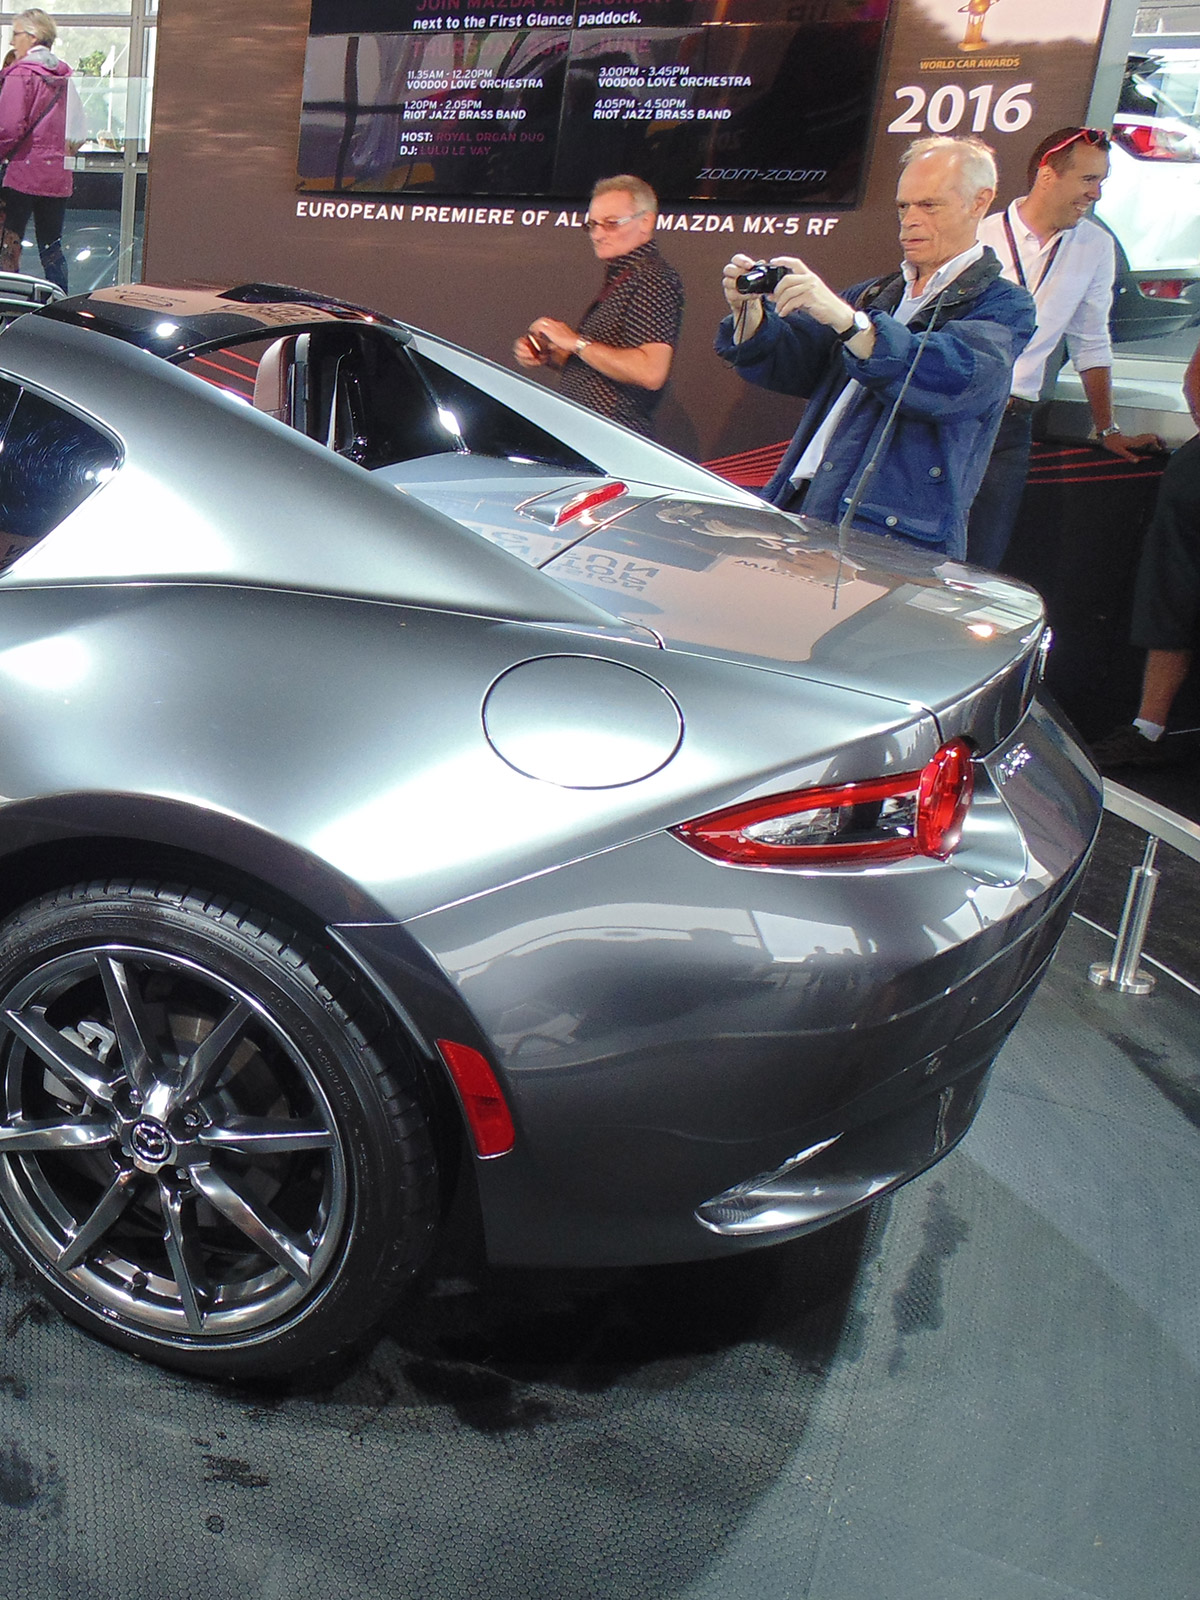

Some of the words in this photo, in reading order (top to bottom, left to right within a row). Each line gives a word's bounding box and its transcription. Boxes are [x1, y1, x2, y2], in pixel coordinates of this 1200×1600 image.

[412, 17, 442, 30] next
[446, 16, 460, 29] to
[464, 15, 486, 28] the
[489, 14, 522, 27] First
[526, 13, 573, 26] Glance
[578, 10, 642, 27] paddock.
[920, 61, 955, 69] WORLD
[956, 60, 976, 68] CAR
[977, 58, 1020, 68] AWARDS
[407, 70, 444, 80] 11.35AM
[452, 69, 492, 79] 12.20PM
[599, 67, 639, 76] 3.00PM
[648, 66, 689, 76] 3.45PM
[406, 80, 448, 89] VOODOO
[450, 79, 477, 89] LOVE
[479, 79, 543, 88] ORCHESTRA
[598, 77, 645, 87] VOODOO
[647, 77, 677, 87] LOVE
[680, 76, 751, 87] ORCHESTRA
[404, 101, 437, 110] 1.20PM
[445, 100, 482, 110] 2.05PM
[595, 99, 635, 109] 4.05PM
[644, 99, 686, 108] 4.50PM
[887, 83, 1033, 133] 2016
[403, 110, 426, 119] RIOT
[428, 110, 456, 119] JAZZ
[458, 110, 494, 119] BRASS
[495, 110, 526, 119] BAND
[593, 110, 620, 119] RIOT
[622, 110, 652, 119] JAZZ
[654, 109, 695, 119] BRASS
[697, 109, 732, 119] BAND
[401, 132, 433, 142] HOST:
[435, 132, 472, 142] ROYAL
[476, 132, 517, 142] ORGAN
[519, 132, 545, 142] DUO
[400, 145, 418, 155] DJ:
[452, 146, 466, 155] LE
[296, 202, 404, 220] EUROPEAN
[411, 206, 515, 225] PREMIERE
[521, 210, 550, 226] OF
[656, 214, 735, 232] MAZDA
[743, 216, 799, 235] MX-5
[806, 218, 839, 236] RF
